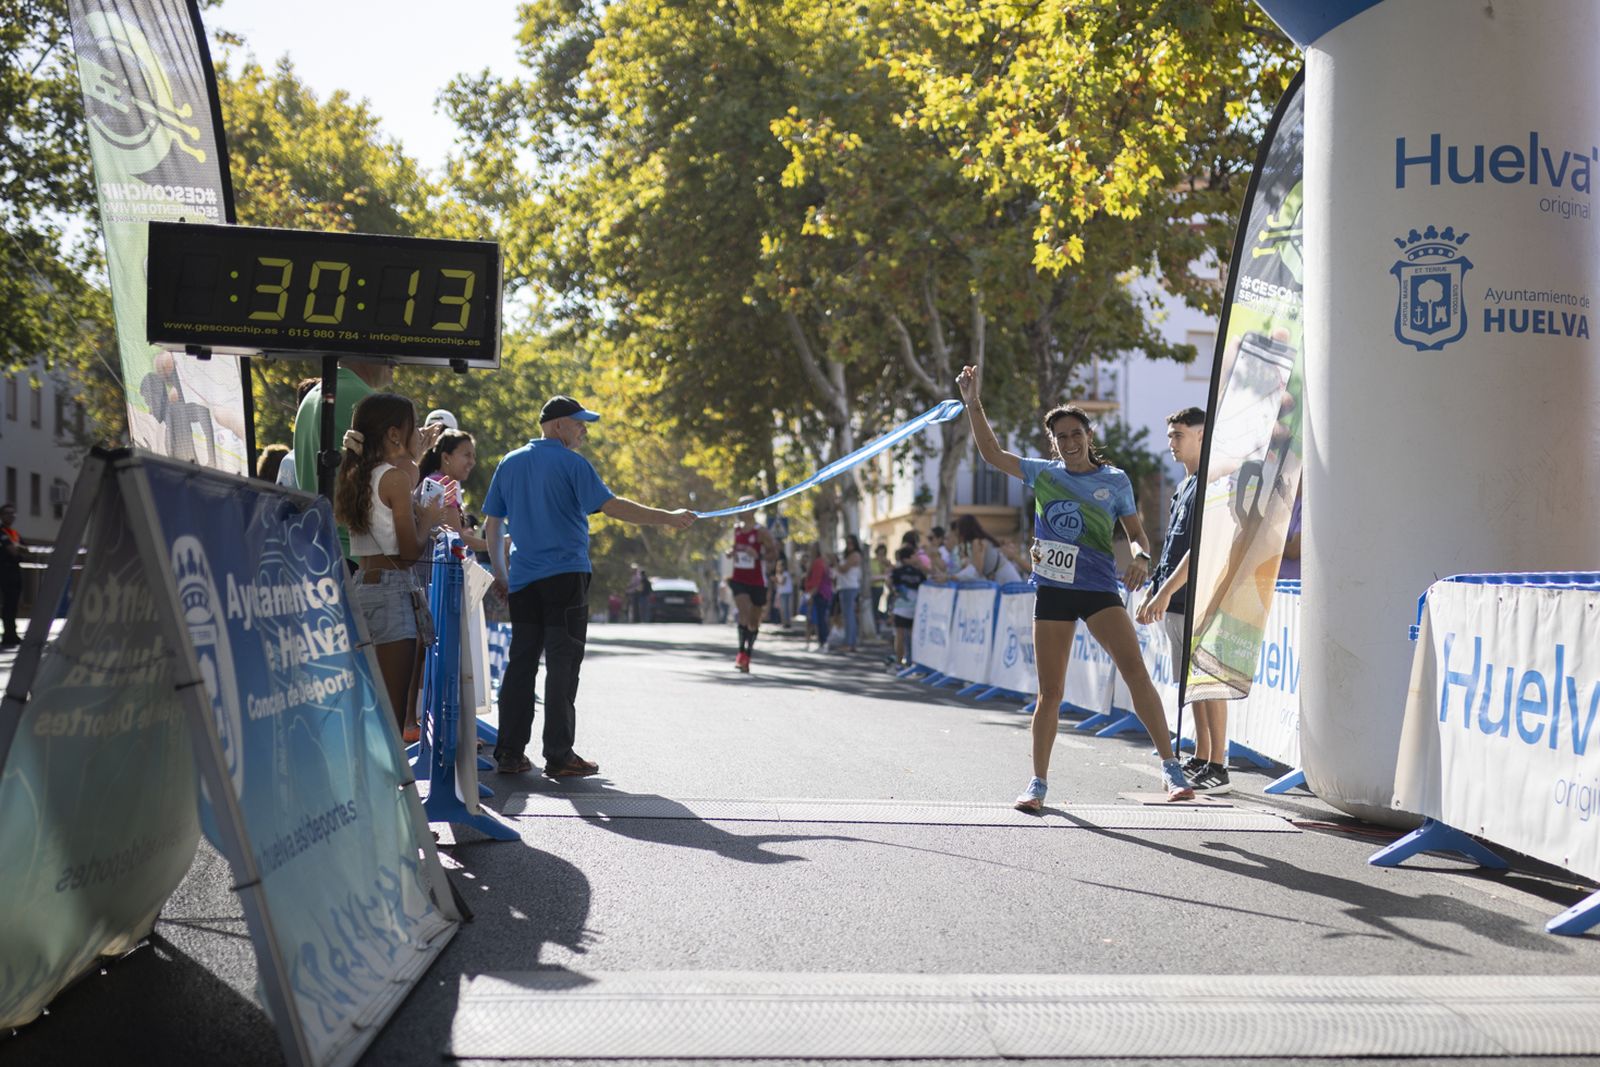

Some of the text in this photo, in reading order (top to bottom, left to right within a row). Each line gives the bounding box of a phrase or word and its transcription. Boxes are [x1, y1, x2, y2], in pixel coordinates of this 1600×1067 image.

[1539, 195, 1591, 219] original
[1484, 288, 1590, 309] Ayuntamiento de
[163, 321, 481, 347] www.gesconchip.es 615 980 784 info@gesconchip.es
[1483, 308, 1590, 340] HUELVA
[1060, 515, 1079, 529] JD
[1047, 549, 1074, 569] 200
[1439, 633, 1600, 757] Huelv
[1554, 772, 1600, 822] origi
